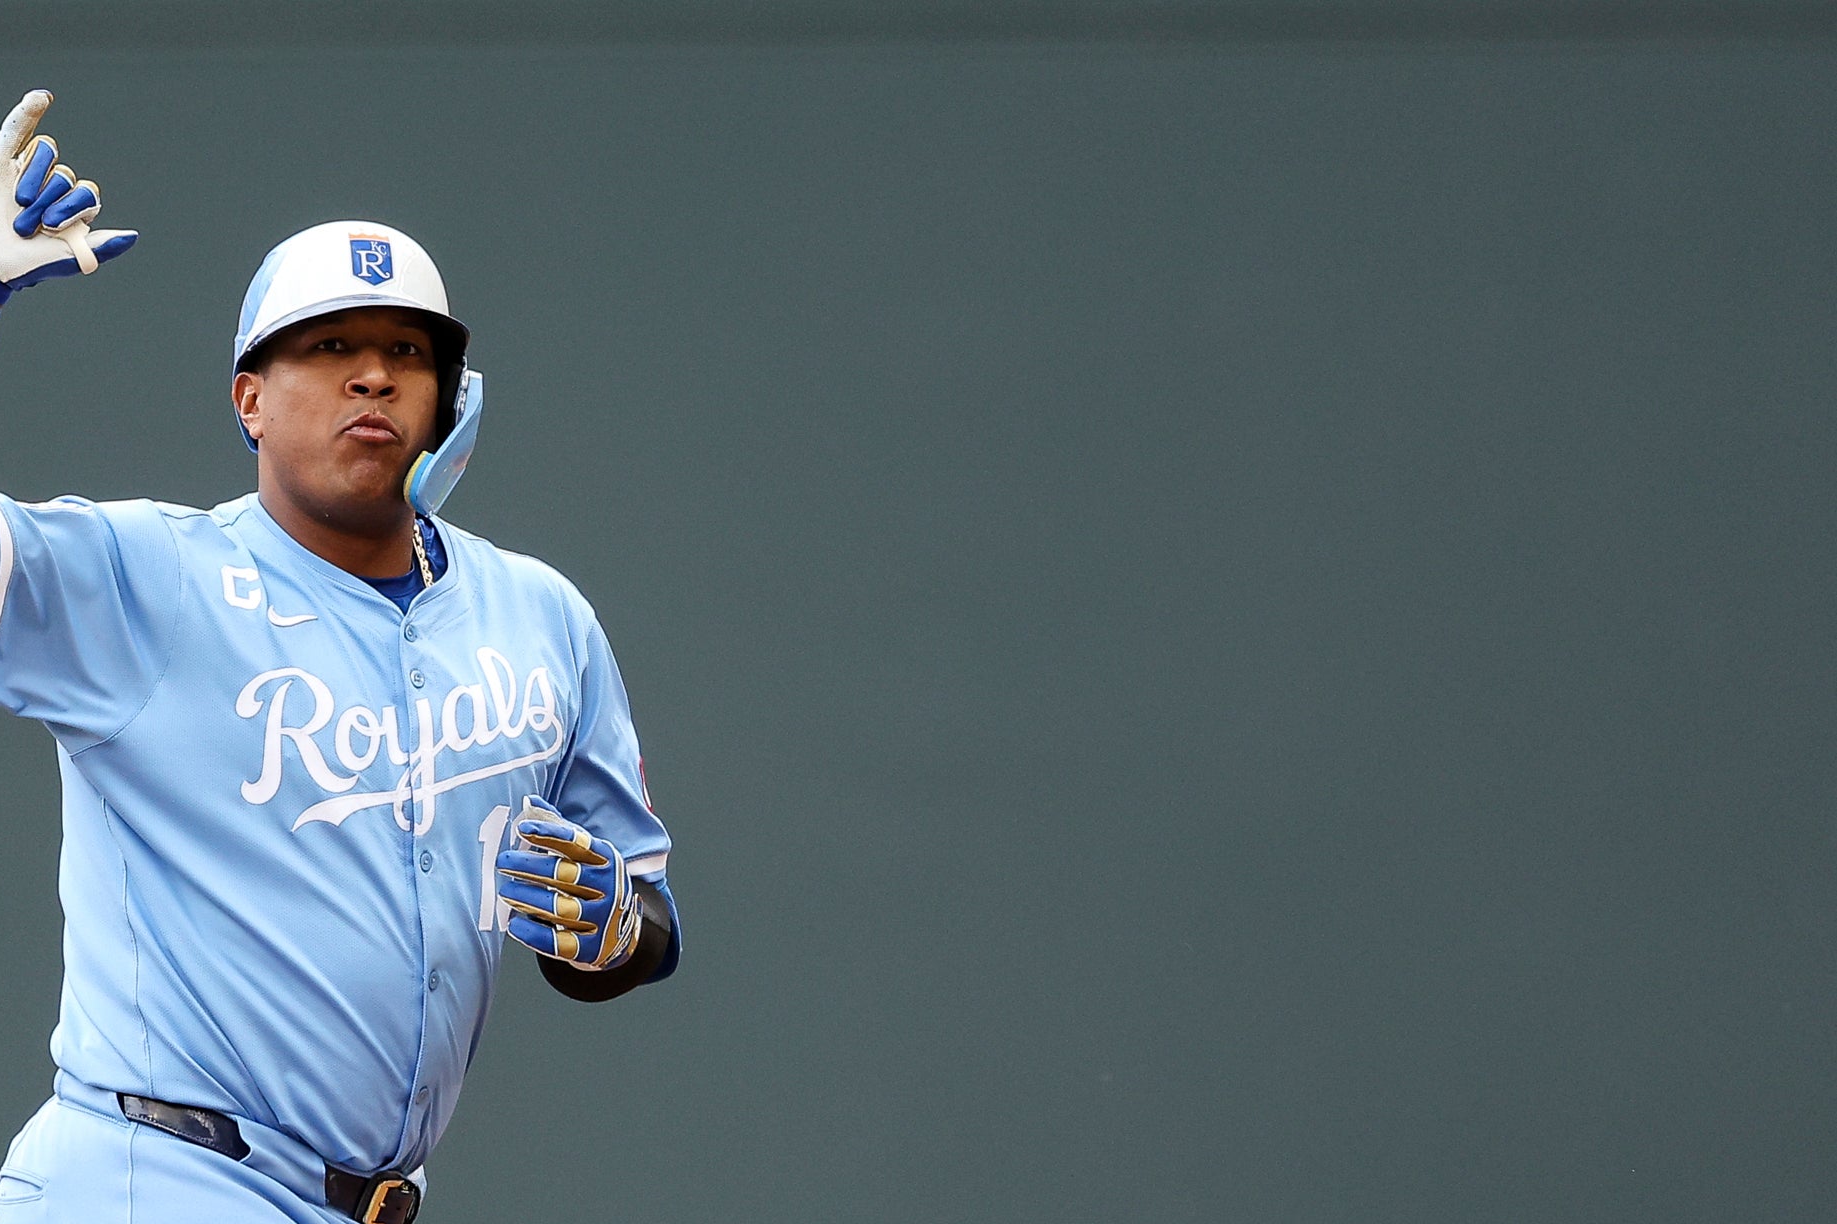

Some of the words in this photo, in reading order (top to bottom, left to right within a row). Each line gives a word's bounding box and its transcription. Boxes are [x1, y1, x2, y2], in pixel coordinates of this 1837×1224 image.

[355, 250, 391, 279] R
[221, 564, 262, 610] C
[235, 646, 564, 836] Royals
[478, 805, 532, 932] 1
